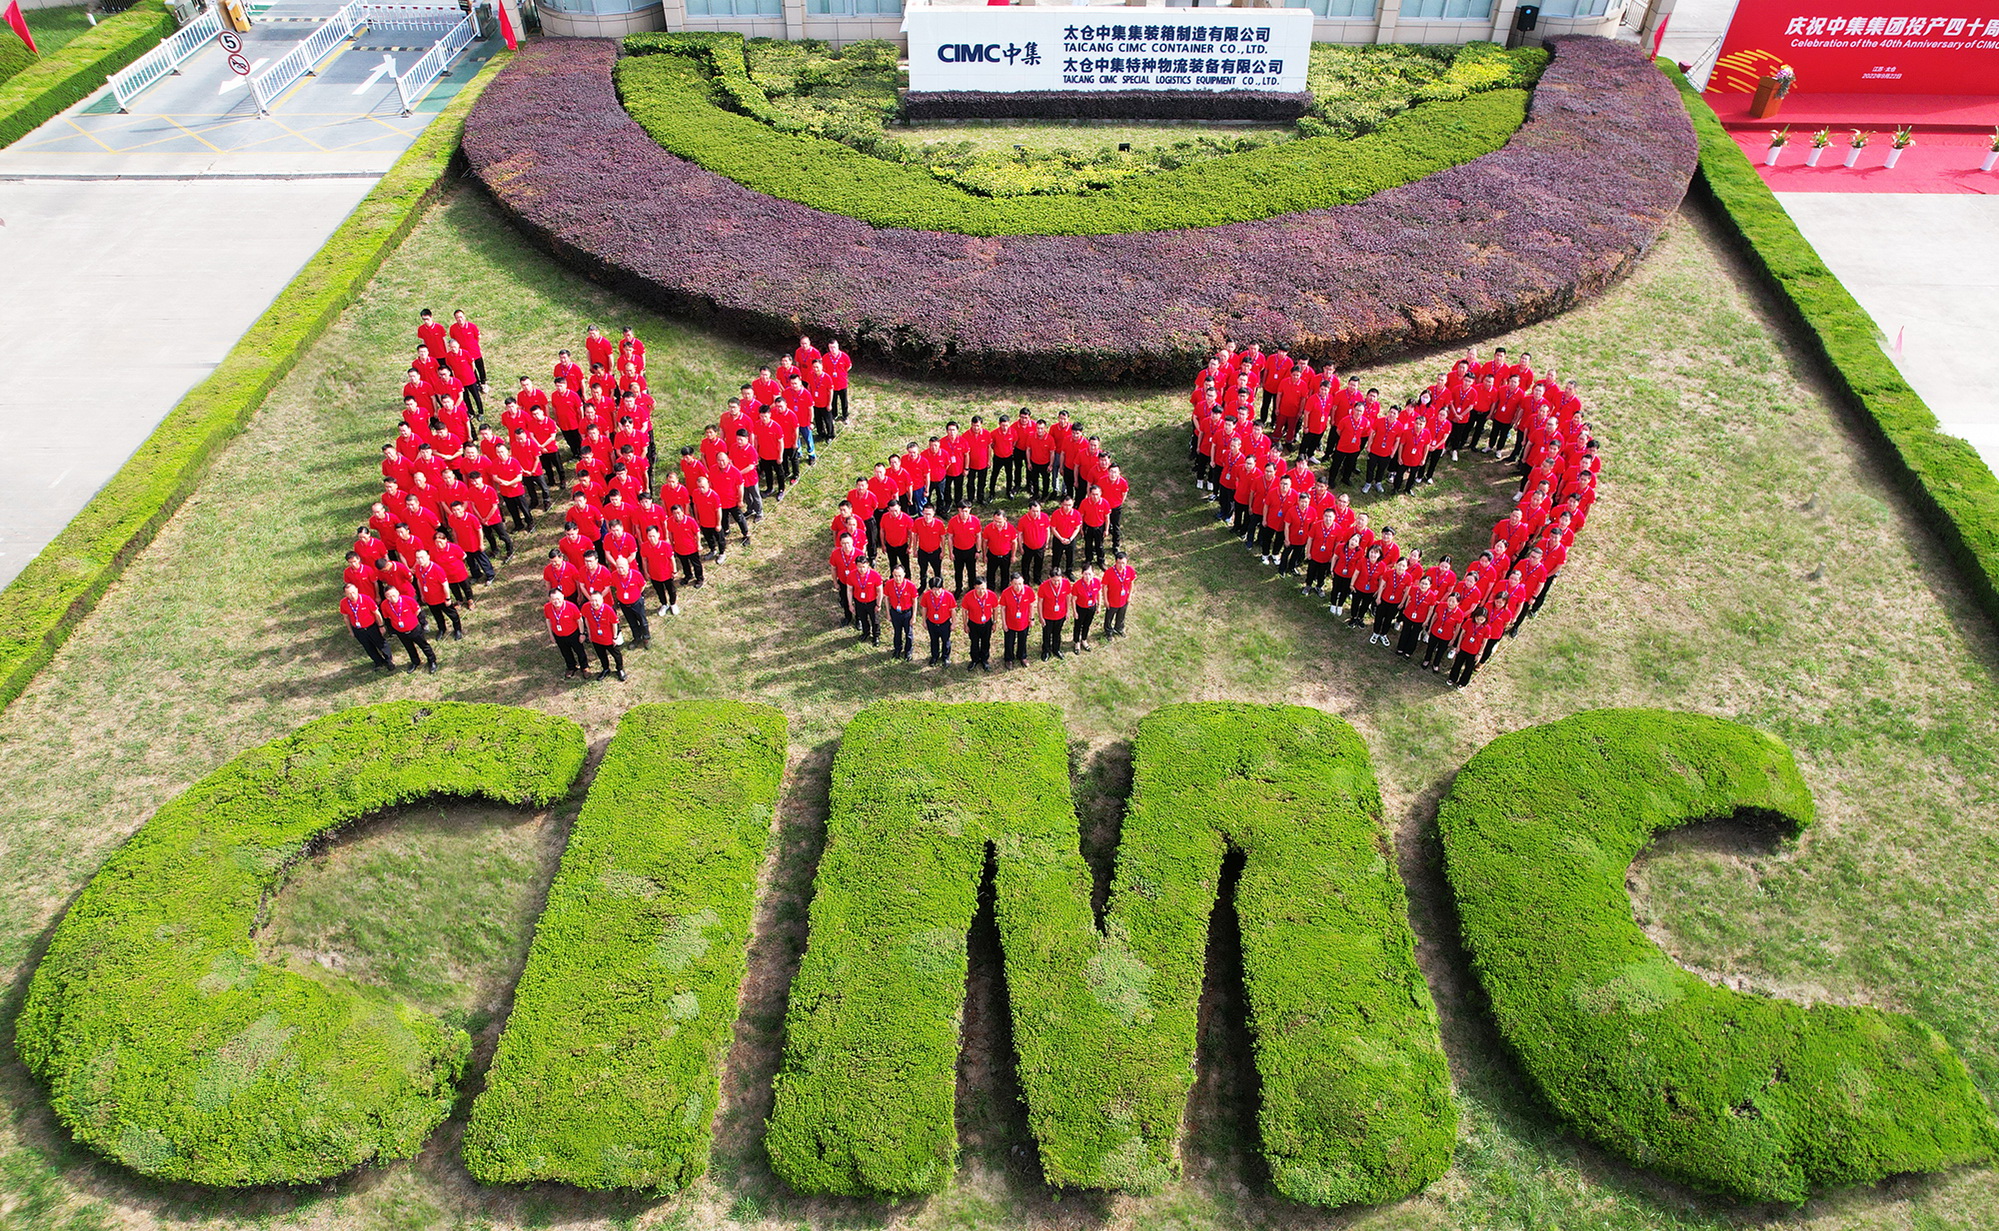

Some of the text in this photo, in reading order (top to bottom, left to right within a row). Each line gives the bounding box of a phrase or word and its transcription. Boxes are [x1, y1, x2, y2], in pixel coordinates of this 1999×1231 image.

[1063, 24, 1271, 42] 太仓中集集装箱制造有限公司
[223, 35, 237, 49] 5
[1063, 42, 1114, 53] TAICANG
[1118, 42, 1147, 53] CIMC
[1151, 43, 1215, 54] CONTAINER
[1790, 38, 1849, 48] Celebration
[1849, 38, 1862, 48] of
[1861, 38, 1878, 48] the
[1879, 39, 1903, 48] 40th
[1902, 39, 1964, 51] Anniversary
[1964, 40, 1977, 49] of
[1062, 56, 1284, 75] 太仓中集特种物流装备有限公司
[1062, 74, 1095, 84] TAICANG
[1099, 75, 1118, 84] CIMC
[1122, 75, 1151, 85] SPECIAL
[1155, 75, 1192, 85] LOGISTICS
[1195, 75, 1237, 85] EQUIPMENT
[15, 699, 1998, 1209] CIMC
